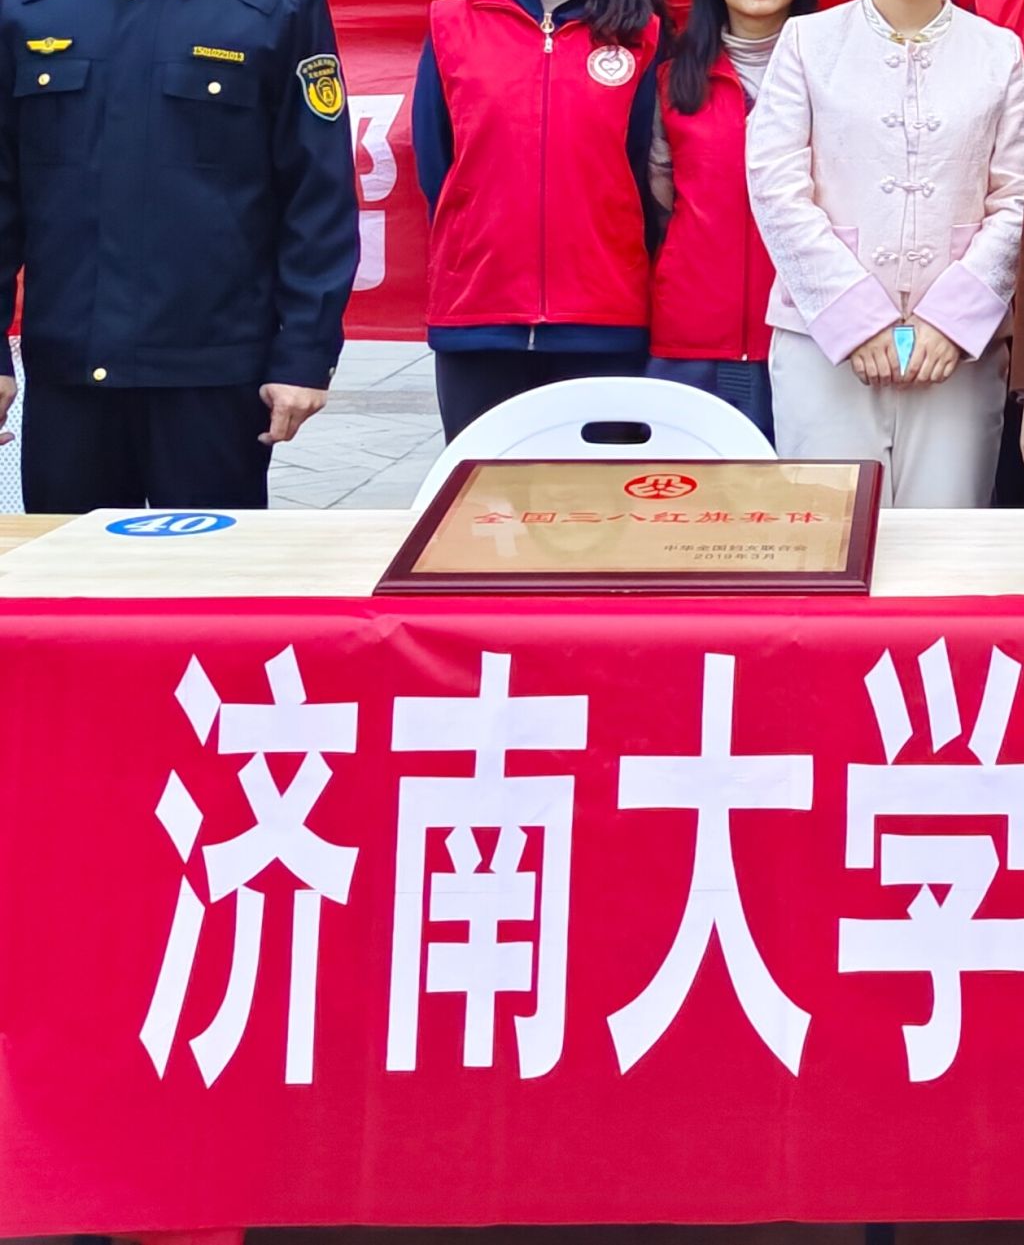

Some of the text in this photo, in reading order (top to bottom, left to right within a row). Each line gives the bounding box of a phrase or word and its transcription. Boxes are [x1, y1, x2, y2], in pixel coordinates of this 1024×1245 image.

[122, 515, 219, 533] 40
[473, 511, 823, 524] 全国三八红旗集体
